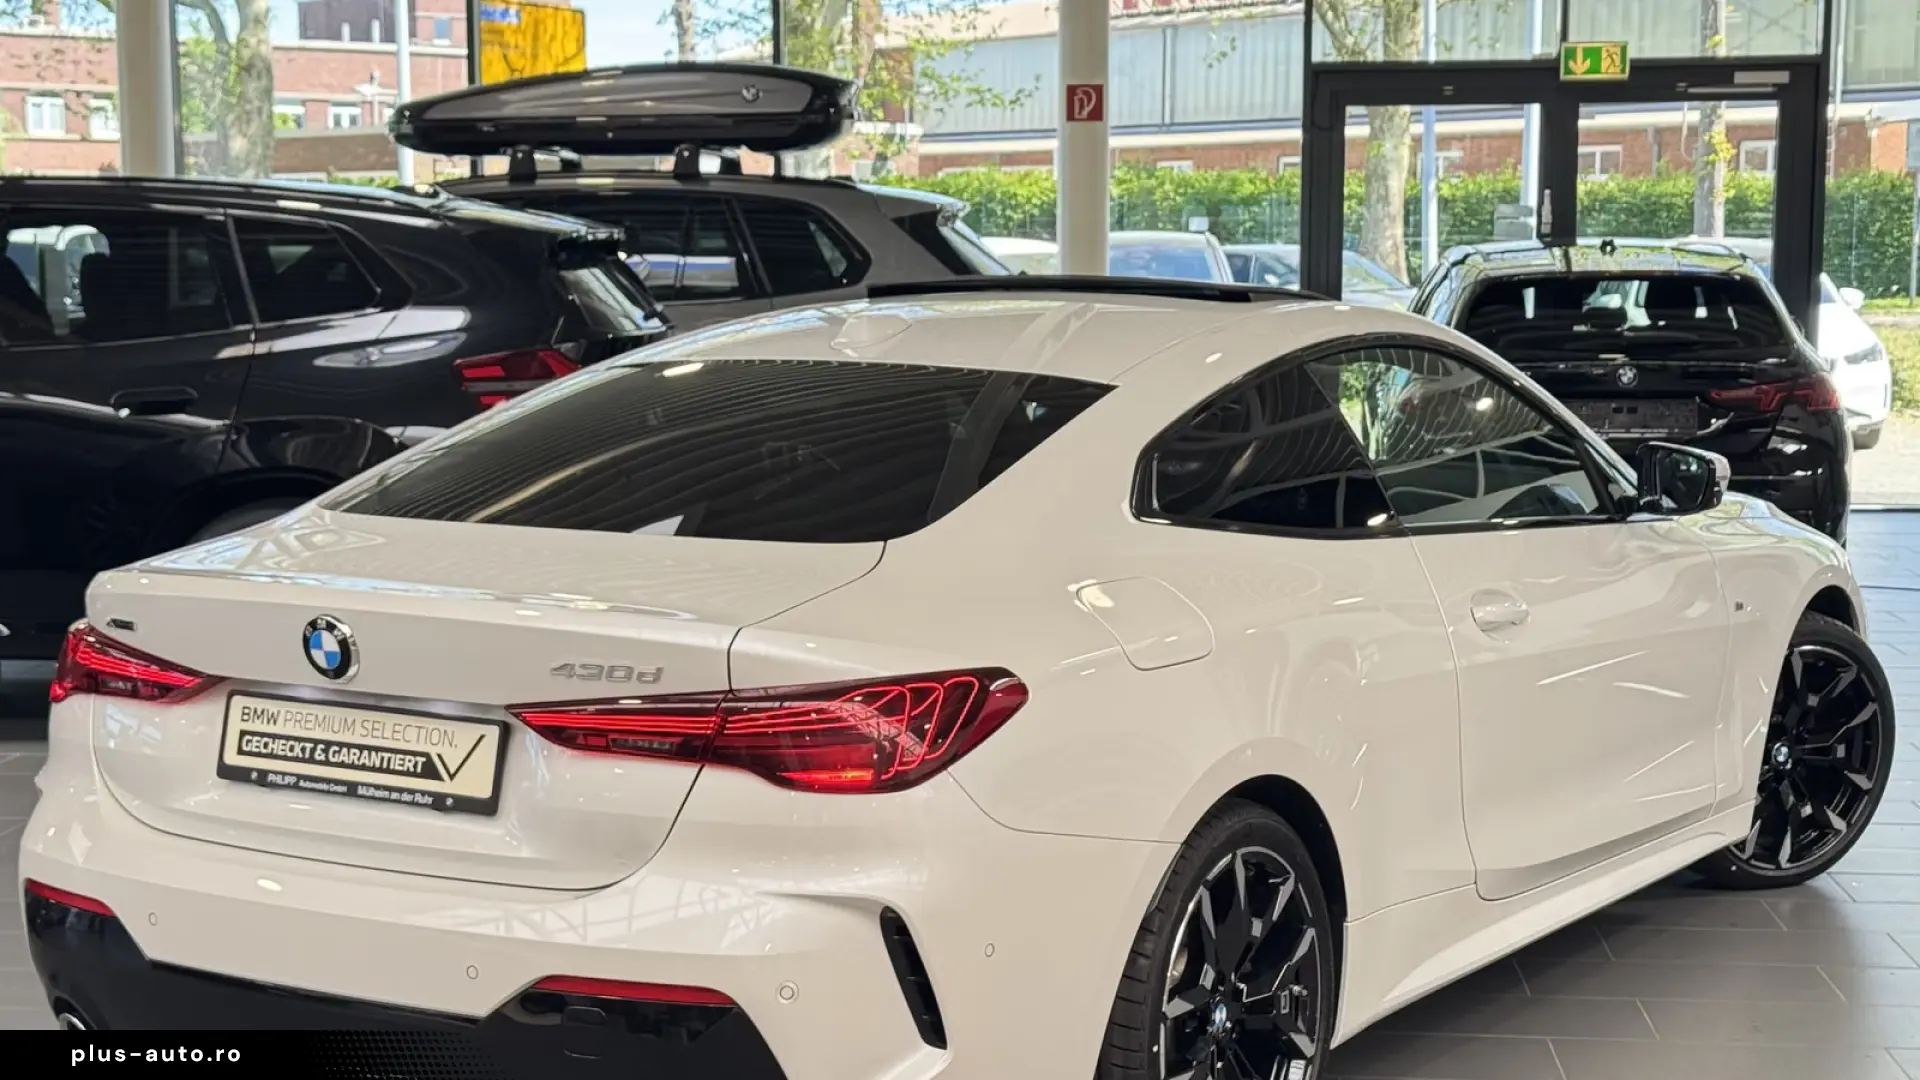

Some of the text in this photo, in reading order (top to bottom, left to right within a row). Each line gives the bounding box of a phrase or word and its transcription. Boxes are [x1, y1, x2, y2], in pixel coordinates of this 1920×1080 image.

[549, 662, 664, 685] 430d
[240, 705, 458, 749] BMW PREMIUM SELECTION.
[241, 734, 426, 774] GECHECKT & GARANTIERT
[267, 773, 297, 786] PHILIPP
[414, 792, 434, 805] Ruhr
